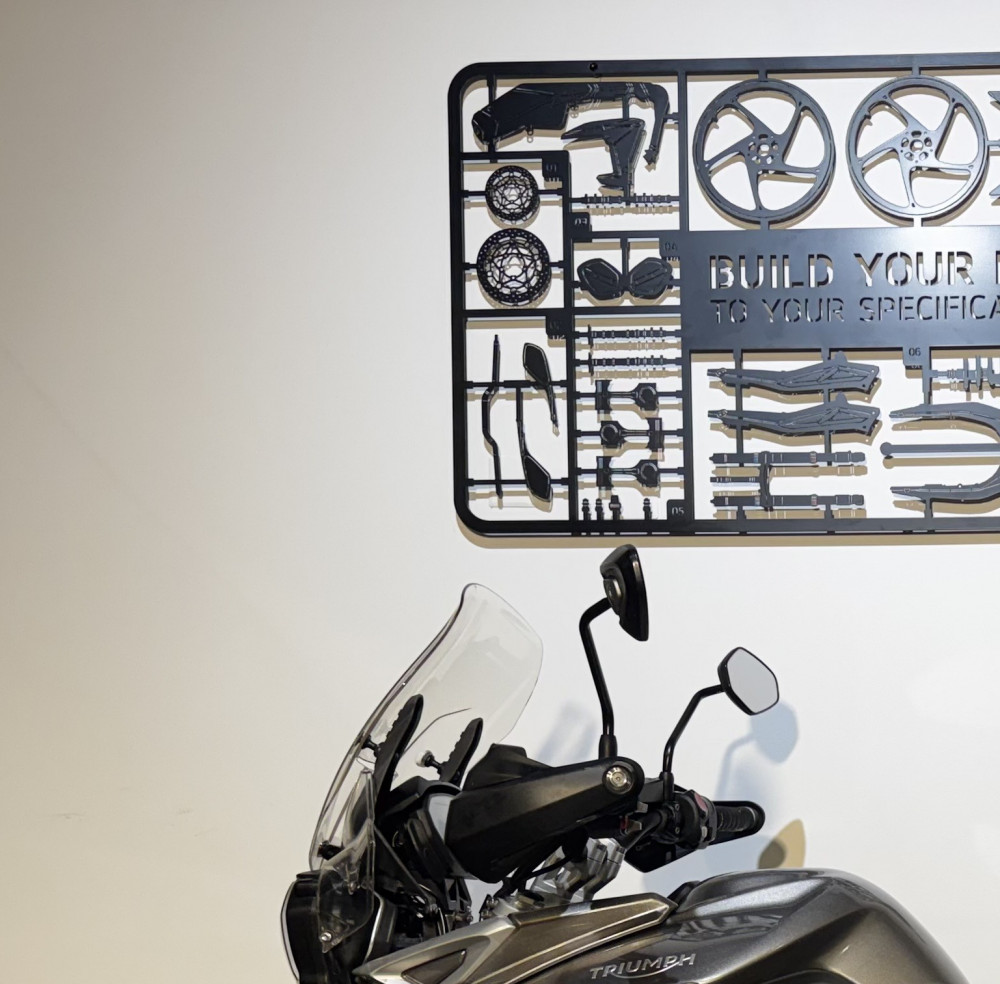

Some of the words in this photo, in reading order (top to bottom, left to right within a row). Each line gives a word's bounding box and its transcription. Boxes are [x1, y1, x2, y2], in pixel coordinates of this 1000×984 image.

[709, 254, 834, 289] BUILD
[853, 251, 974, 287] YOUR
[710, 299, 748, 324] TO
[762, 297, 845, 323] YOUR
[908, 347, 922, 356] 06
[590, 953, 697, 979] TRIUMPH
